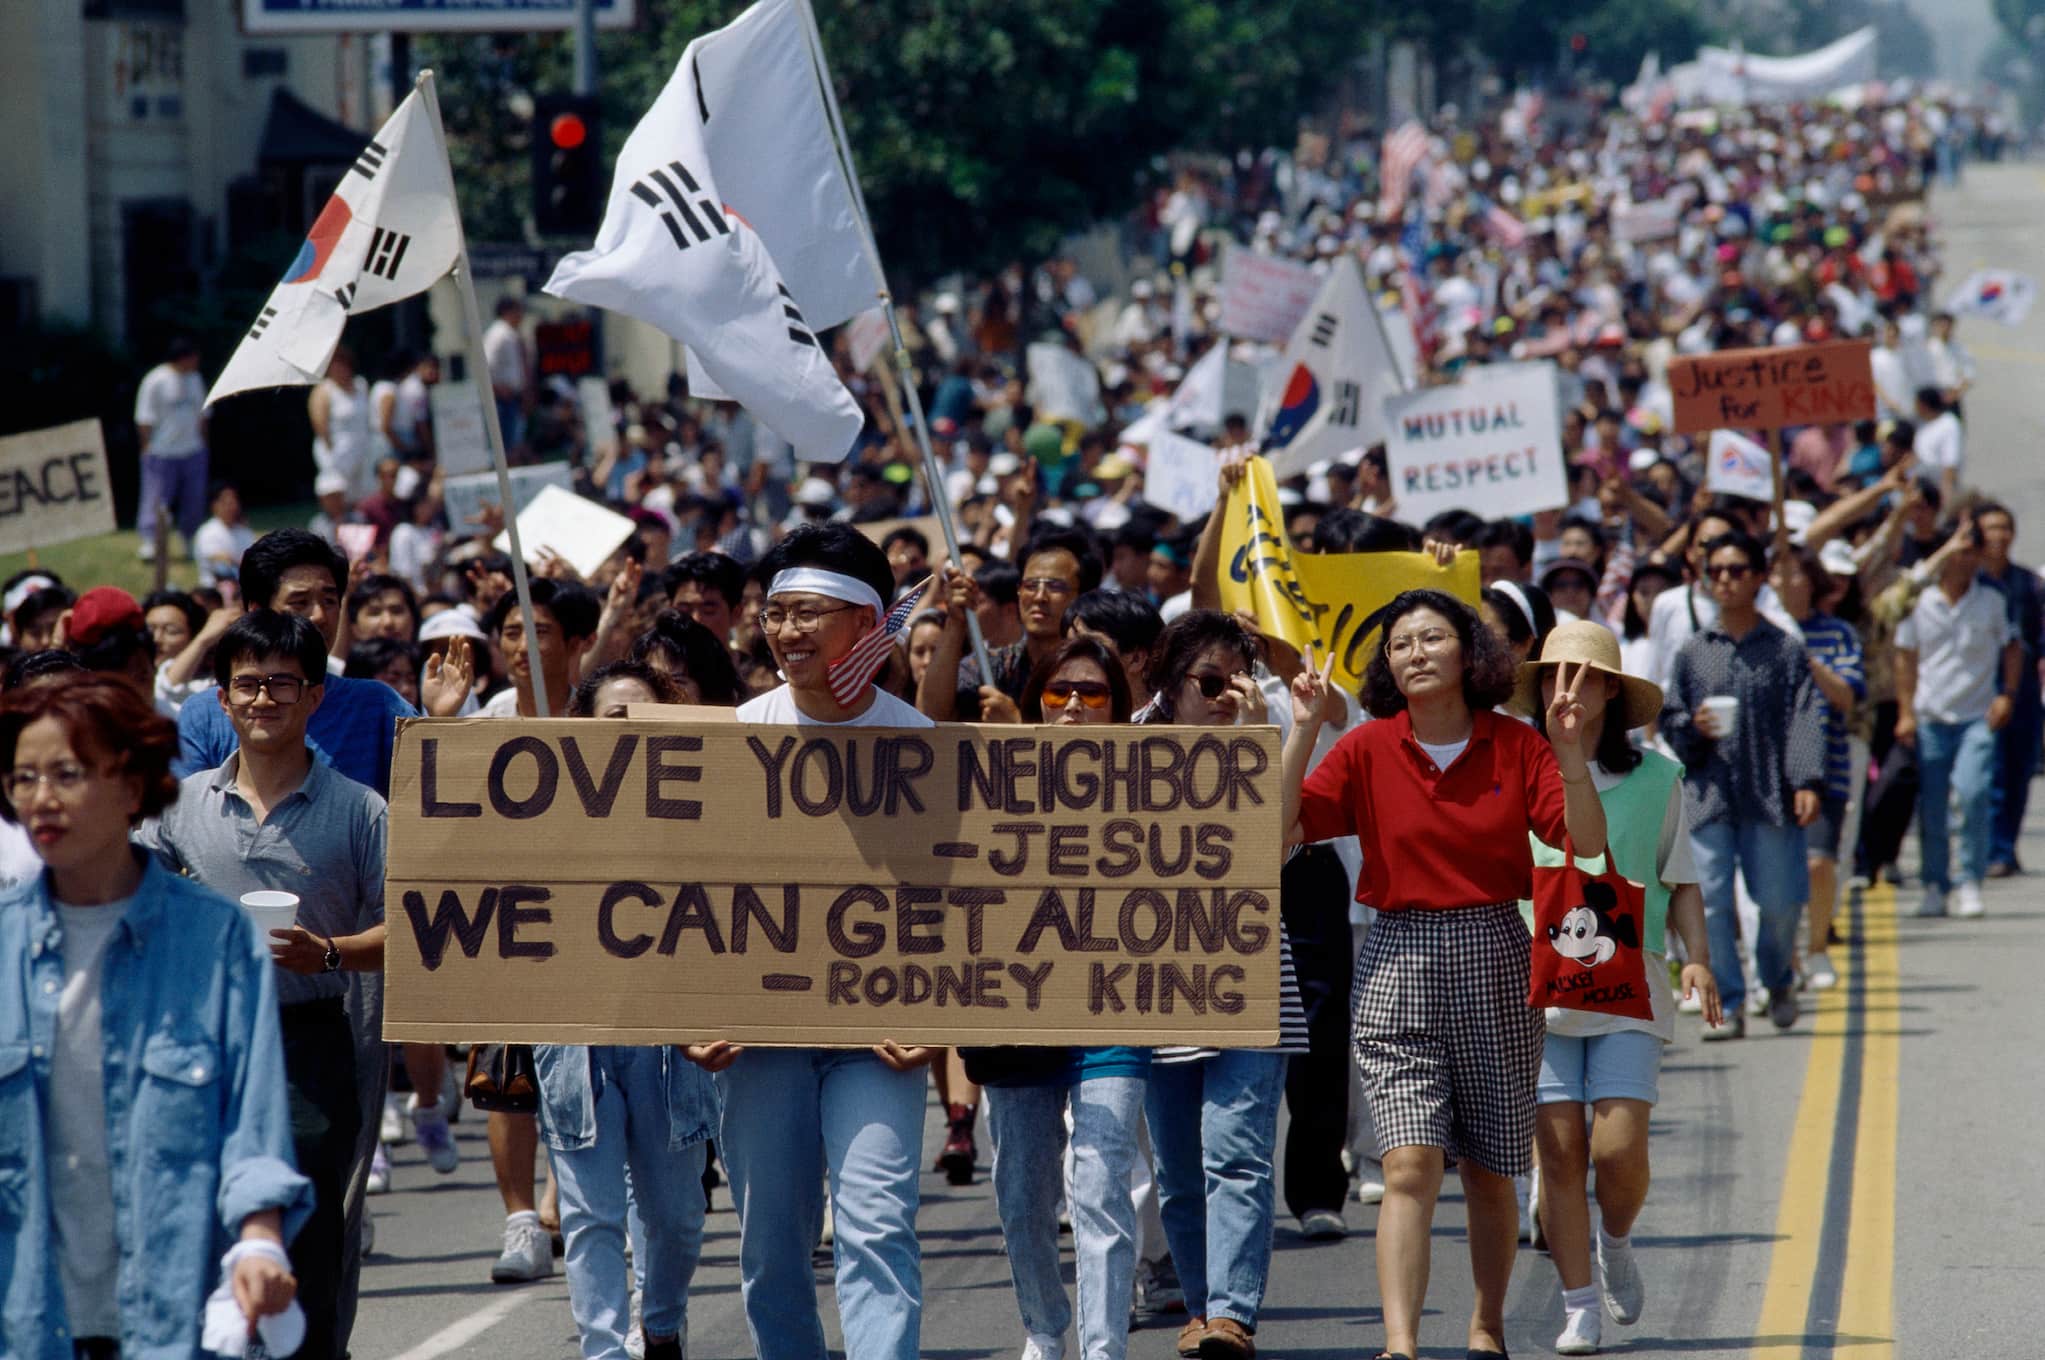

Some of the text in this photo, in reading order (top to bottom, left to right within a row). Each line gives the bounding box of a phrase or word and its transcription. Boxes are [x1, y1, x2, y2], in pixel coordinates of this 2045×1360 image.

[1679, 356, 1826, 397] Justice
[1404, 401, 1525, 442] MUTUAL
[1404, 446, 1538, 493] RESPECT
[420, 733, 1268, 819] LOVE YOUR NEIGHBOR
[402, 880, 1270, 971] WE CAN GET ALONG
[1088, 961, 1247, 1016] KING
